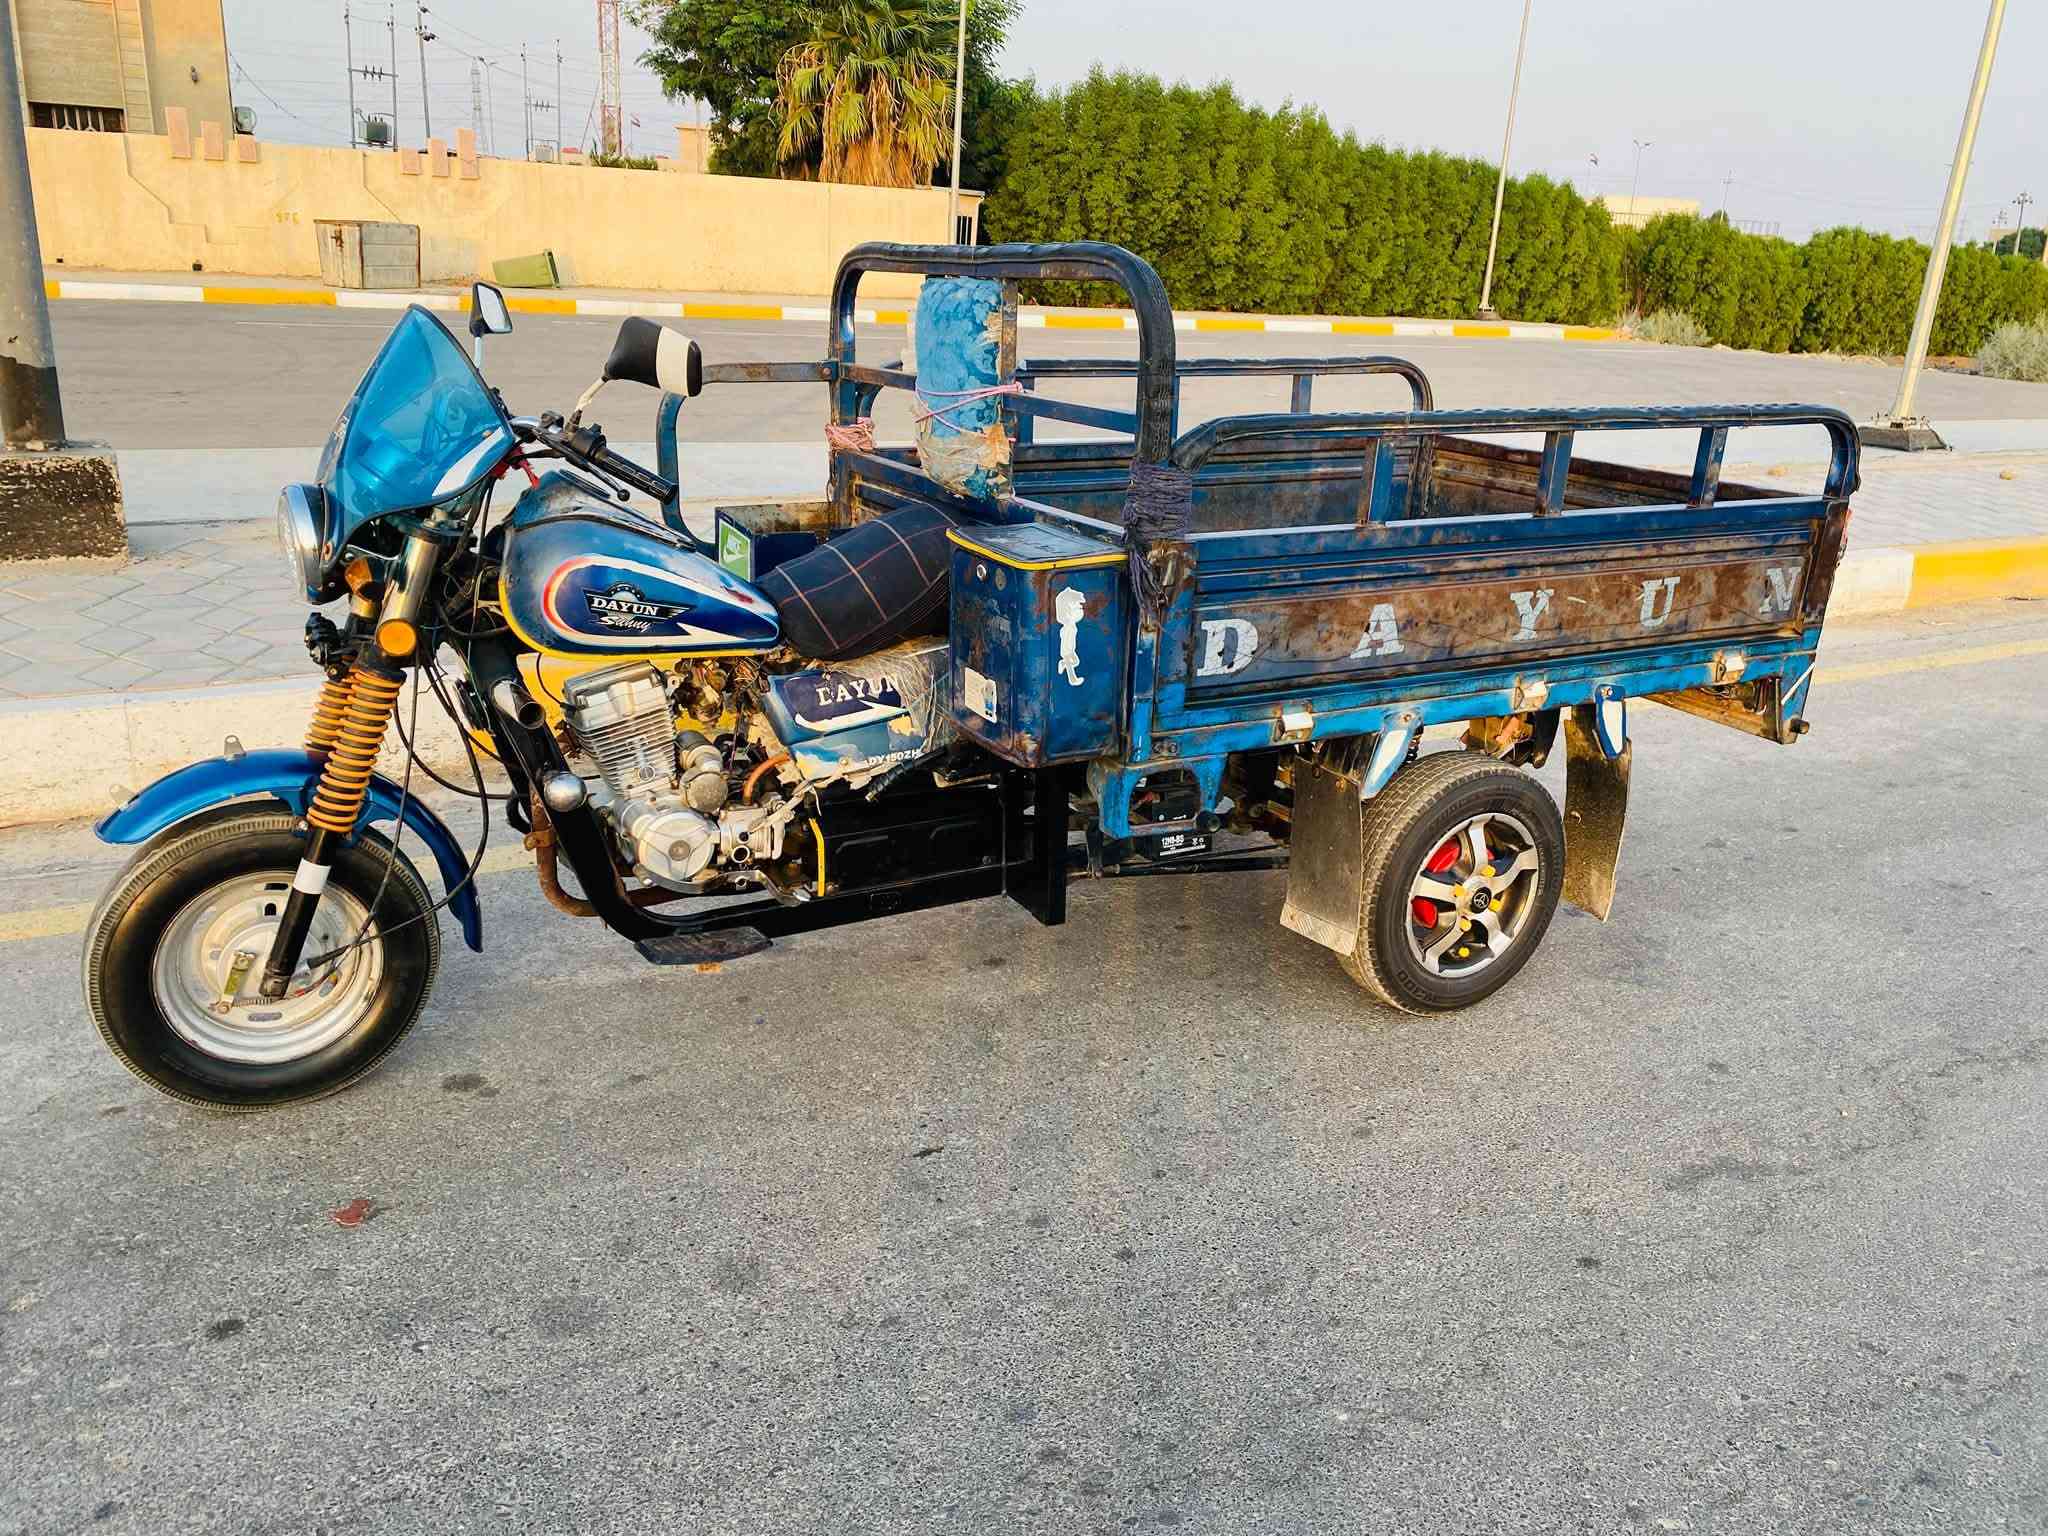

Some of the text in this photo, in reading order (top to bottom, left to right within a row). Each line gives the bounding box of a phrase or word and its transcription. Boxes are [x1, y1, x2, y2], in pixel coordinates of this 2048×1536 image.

[591, 597, 659, 616] DAYUN
[598, 614, 652, 633] Sunny
[1196, 567, 1802, 677] DAYUN
